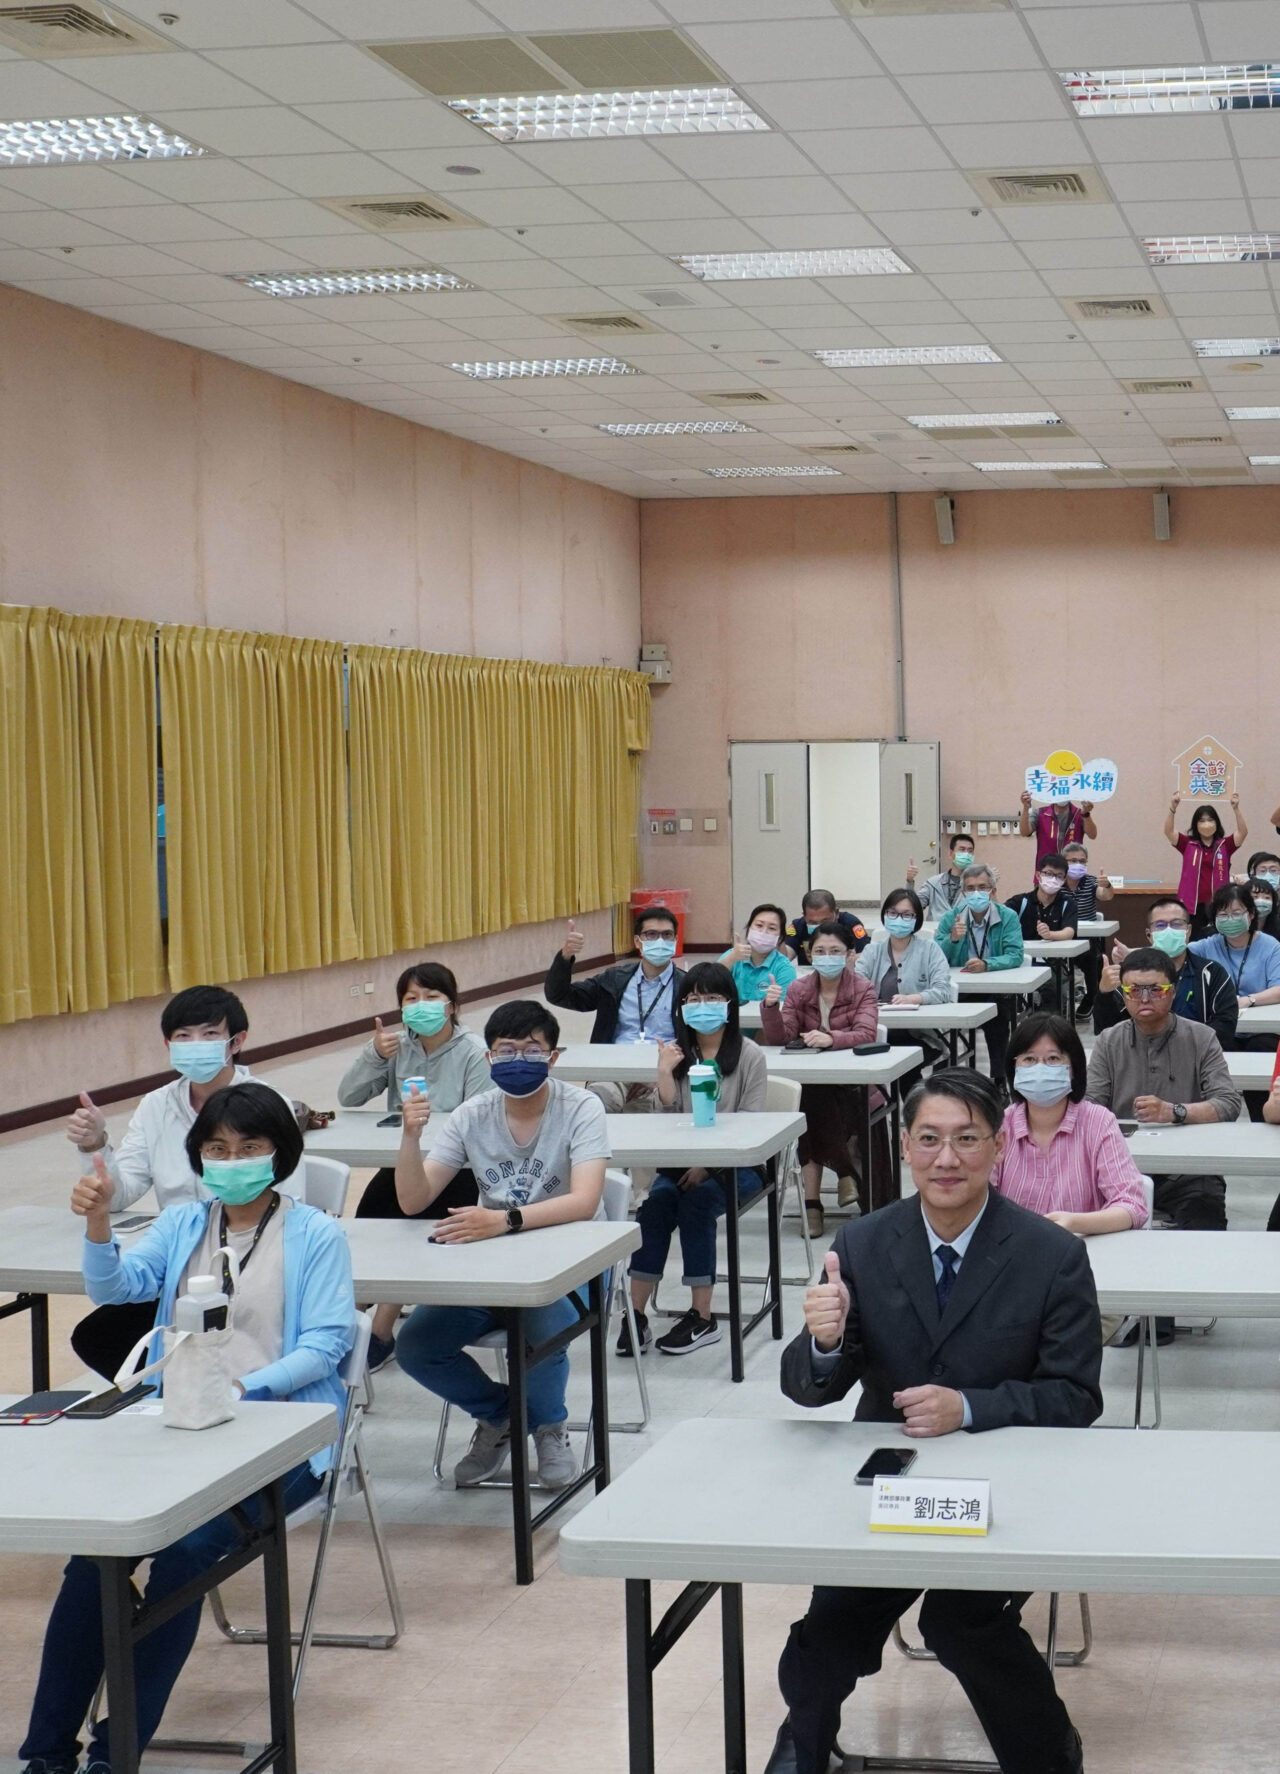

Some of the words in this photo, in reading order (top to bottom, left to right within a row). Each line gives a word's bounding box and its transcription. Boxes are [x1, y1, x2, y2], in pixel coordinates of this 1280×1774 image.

[1027, 769, 1114, 796] 幸福永續
[1190, 776, 1225, 795] 共享
[914, 1496, 981, 1521] 劉志鴻
